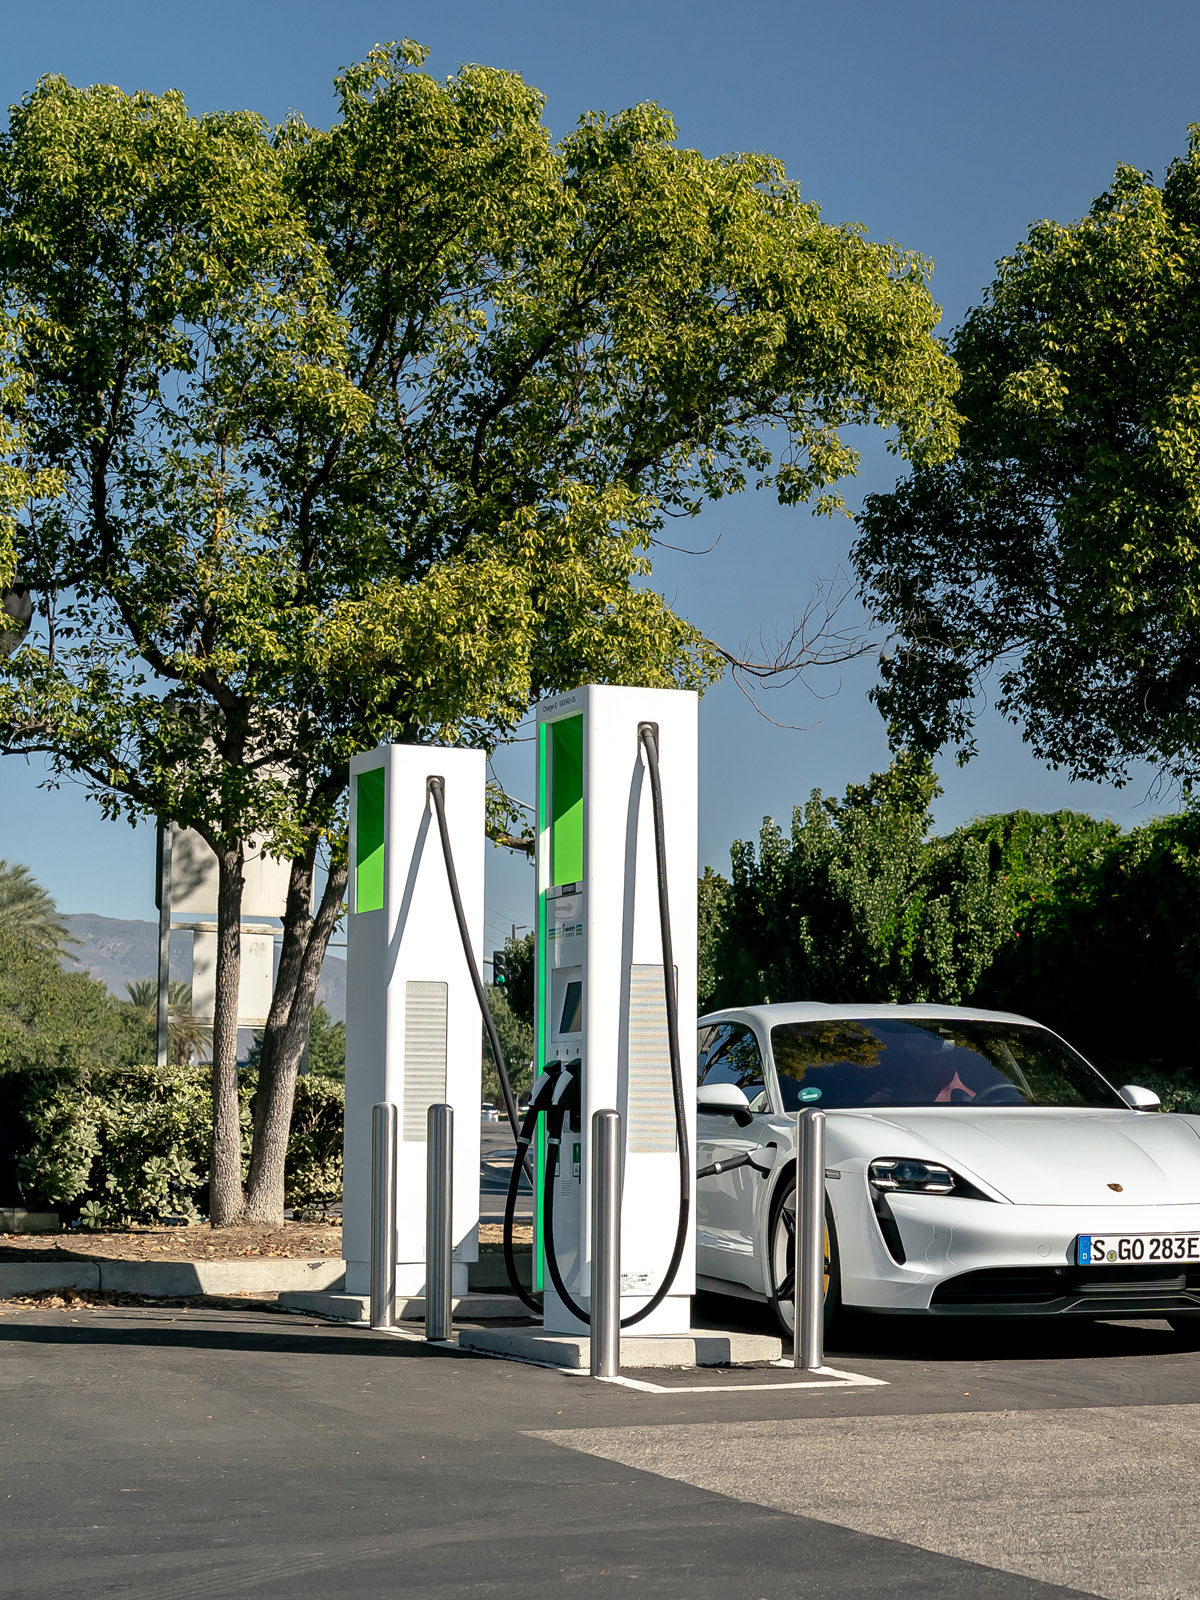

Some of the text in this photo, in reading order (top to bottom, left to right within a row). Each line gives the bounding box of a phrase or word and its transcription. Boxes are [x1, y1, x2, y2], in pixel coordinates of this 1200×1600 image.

[543, 703, 554, 712] Charger
[1092, 1237, 1200, 1261] S GO 283E
[1082, 1252, 1088, 1260] D
